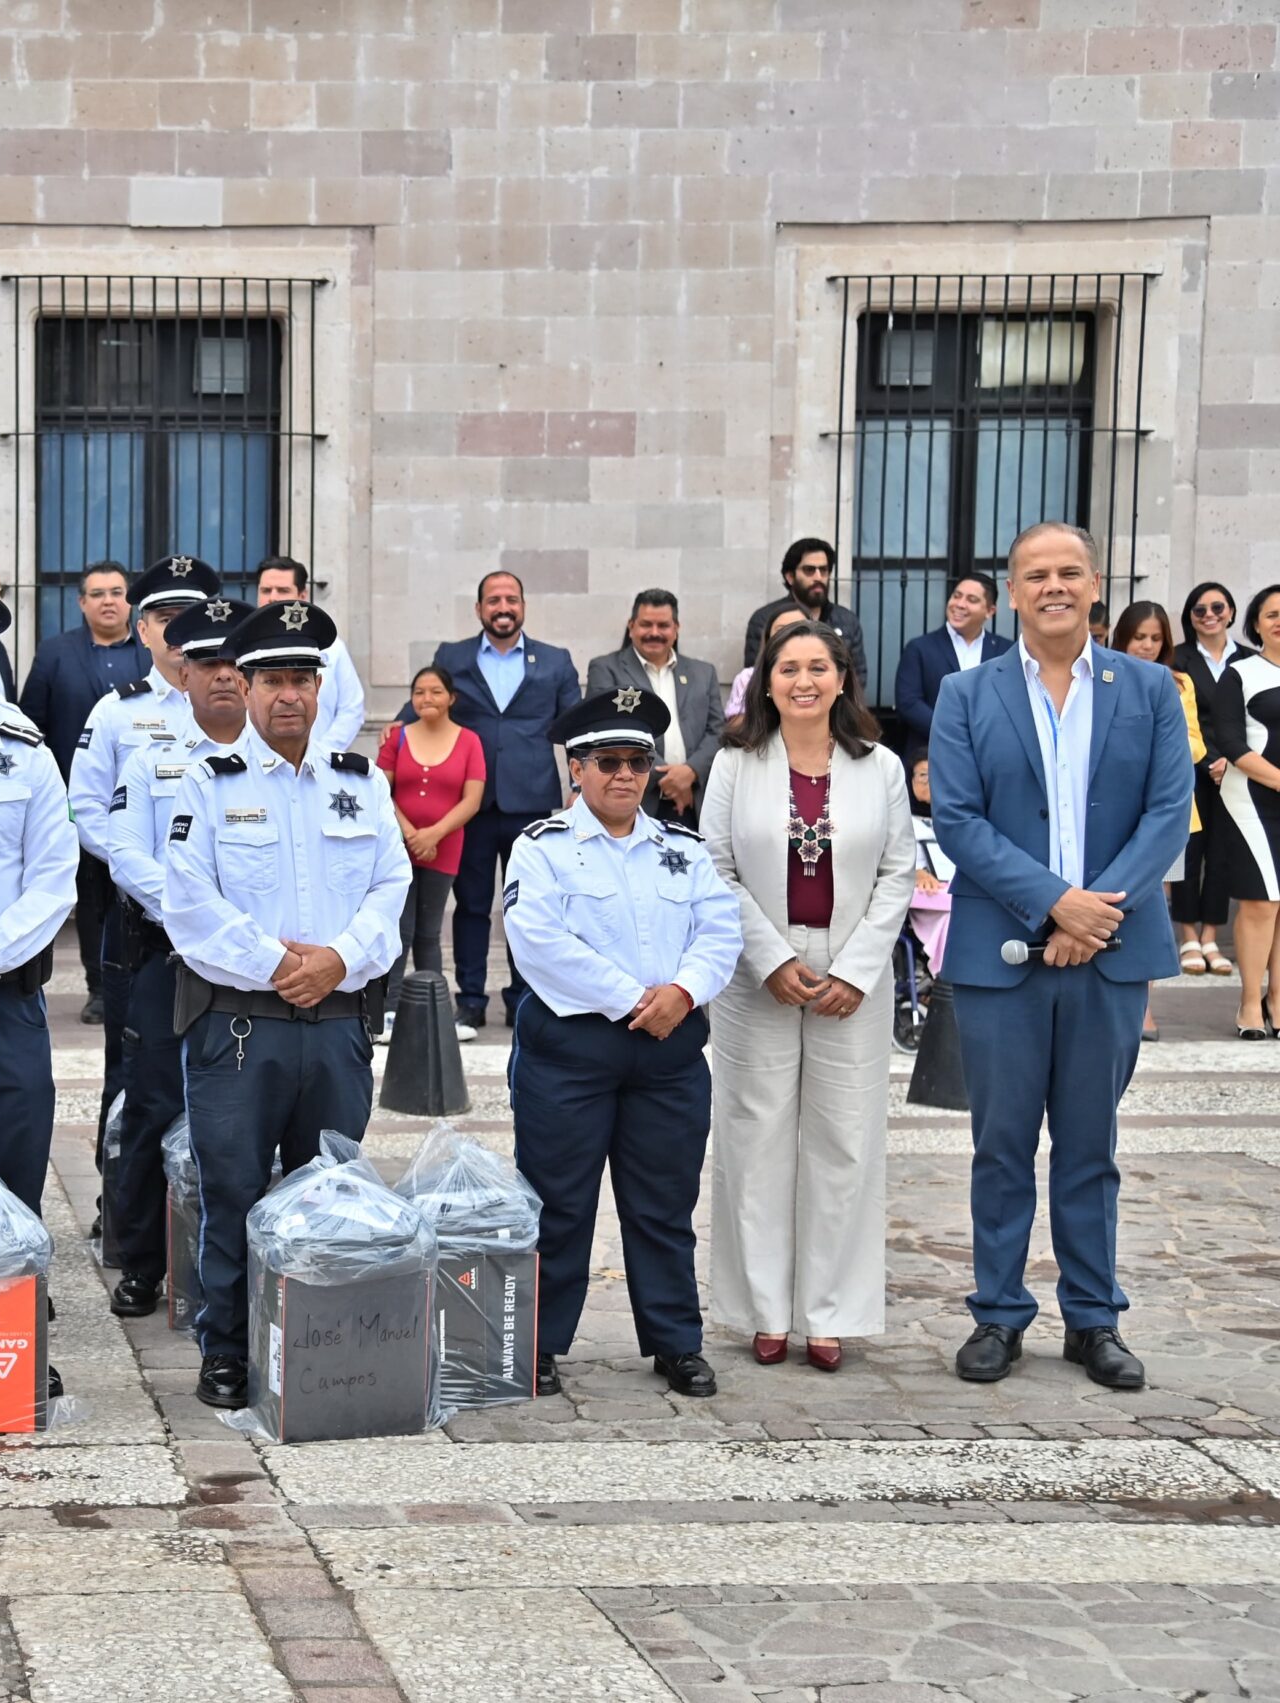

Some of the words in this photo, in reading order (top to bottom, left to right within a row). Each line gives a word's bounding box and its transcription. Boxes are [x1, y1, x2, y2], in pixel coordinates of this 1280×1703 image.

[504, 1274, 517, 1312] READY
[293, 1313, 342, 1349] José
[359, 1312, 418, 1348] Manuel
[503, 1315, 515, 1330] BE
[502, 1333, 515, 1380] ALWAYS
[299, 1367, 377, 1396] Campos
